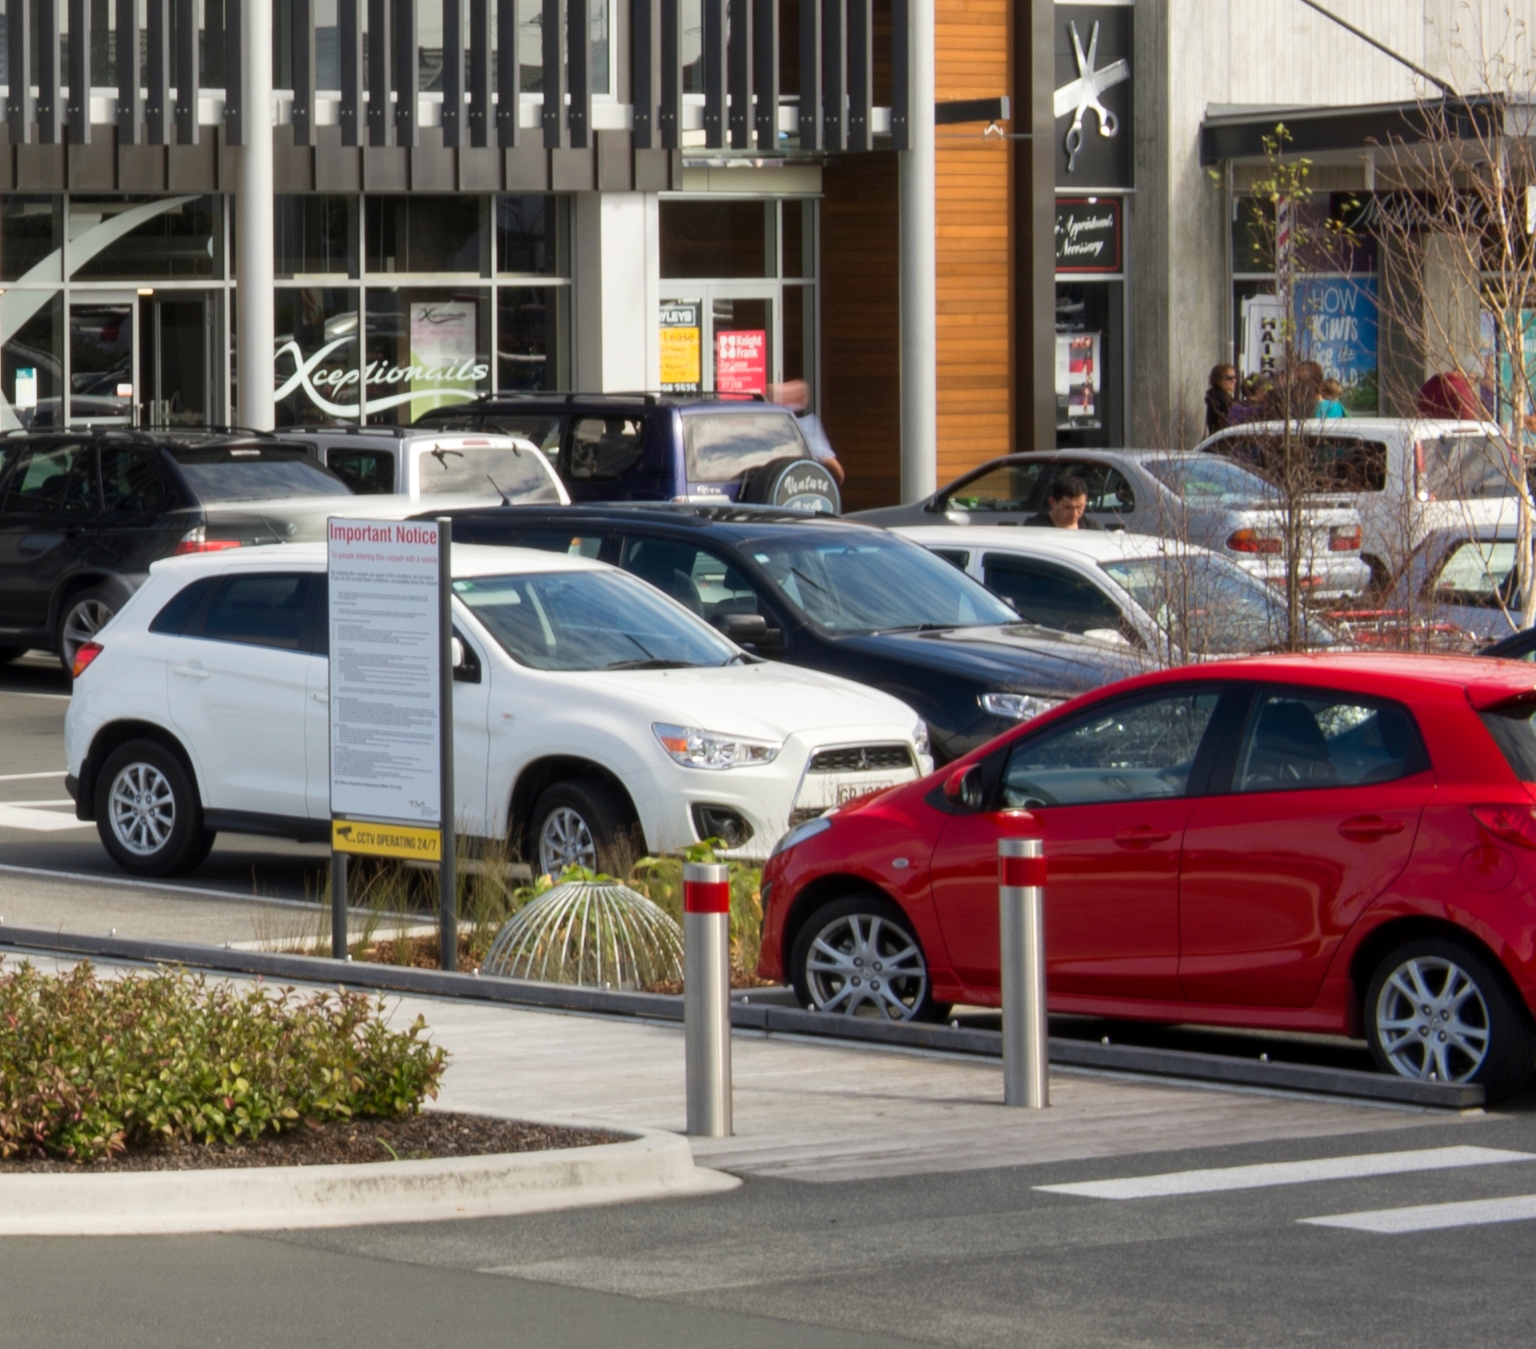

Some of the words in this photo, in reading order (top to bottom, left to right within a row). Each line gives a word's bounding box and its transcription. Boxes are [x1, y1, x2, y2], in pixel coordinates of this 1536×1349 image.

[1312, 287, 1358, 313] HOW
[659, 310, 693, 323] YLEYS
[330, 522, 392, 545] Important
[396, 525, 437, 545] Notice
[357, 831, 376, 846] CCTV
[377, 834, 416, 850] OPERATING
[417, 838, 437, 852] 24/7
